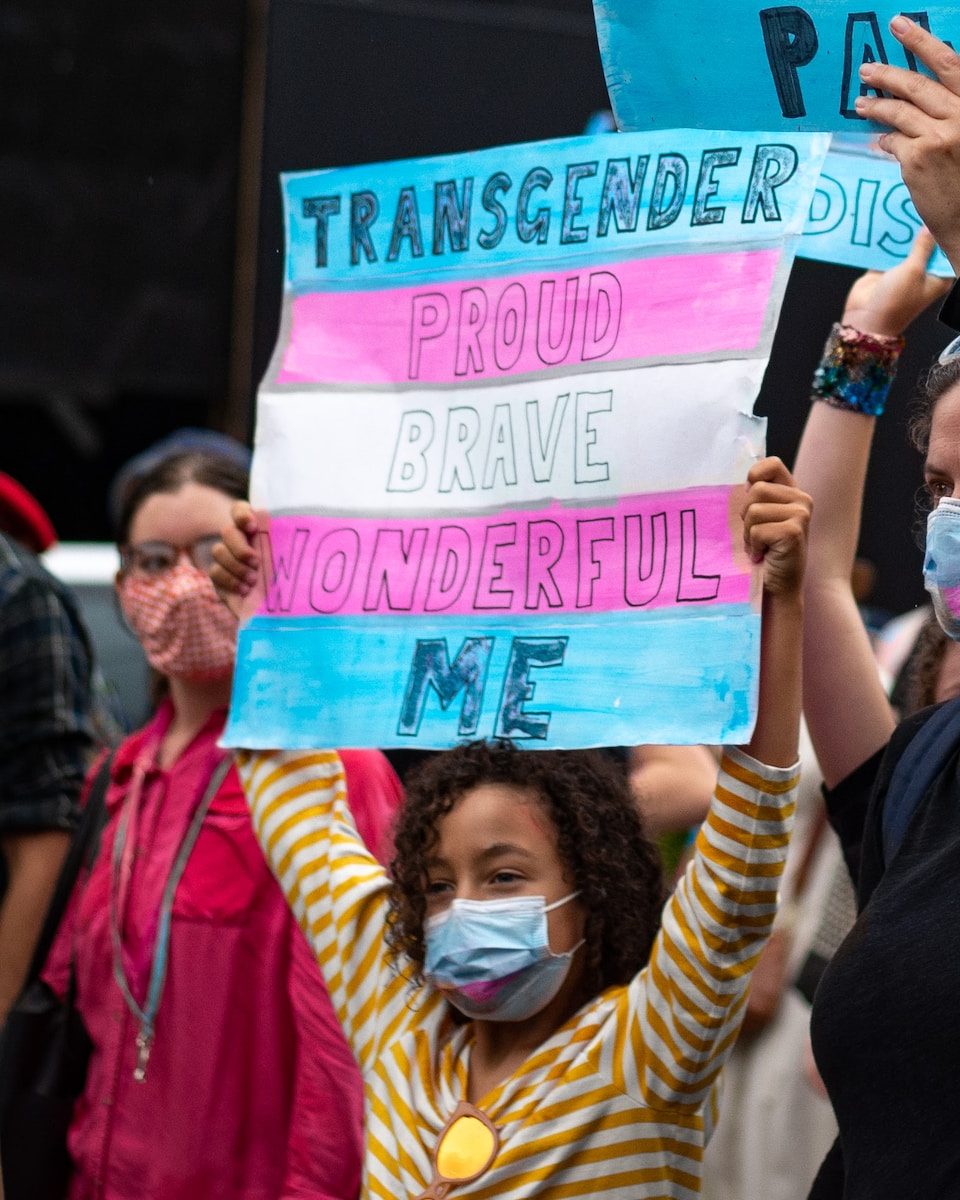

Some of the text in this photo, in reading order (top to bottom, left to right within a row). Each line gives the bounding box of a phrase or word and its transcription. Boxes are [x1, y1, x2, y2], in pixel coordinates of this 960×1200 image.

[301, 143, 799, 269] TRANSGENDER
[407, 270, 623, 380] PROUD
[386, 389, 614, 493] BRAVE
[256, 509, 721, 614] WONDERFUL
[396, 635, 569, 741] ME
